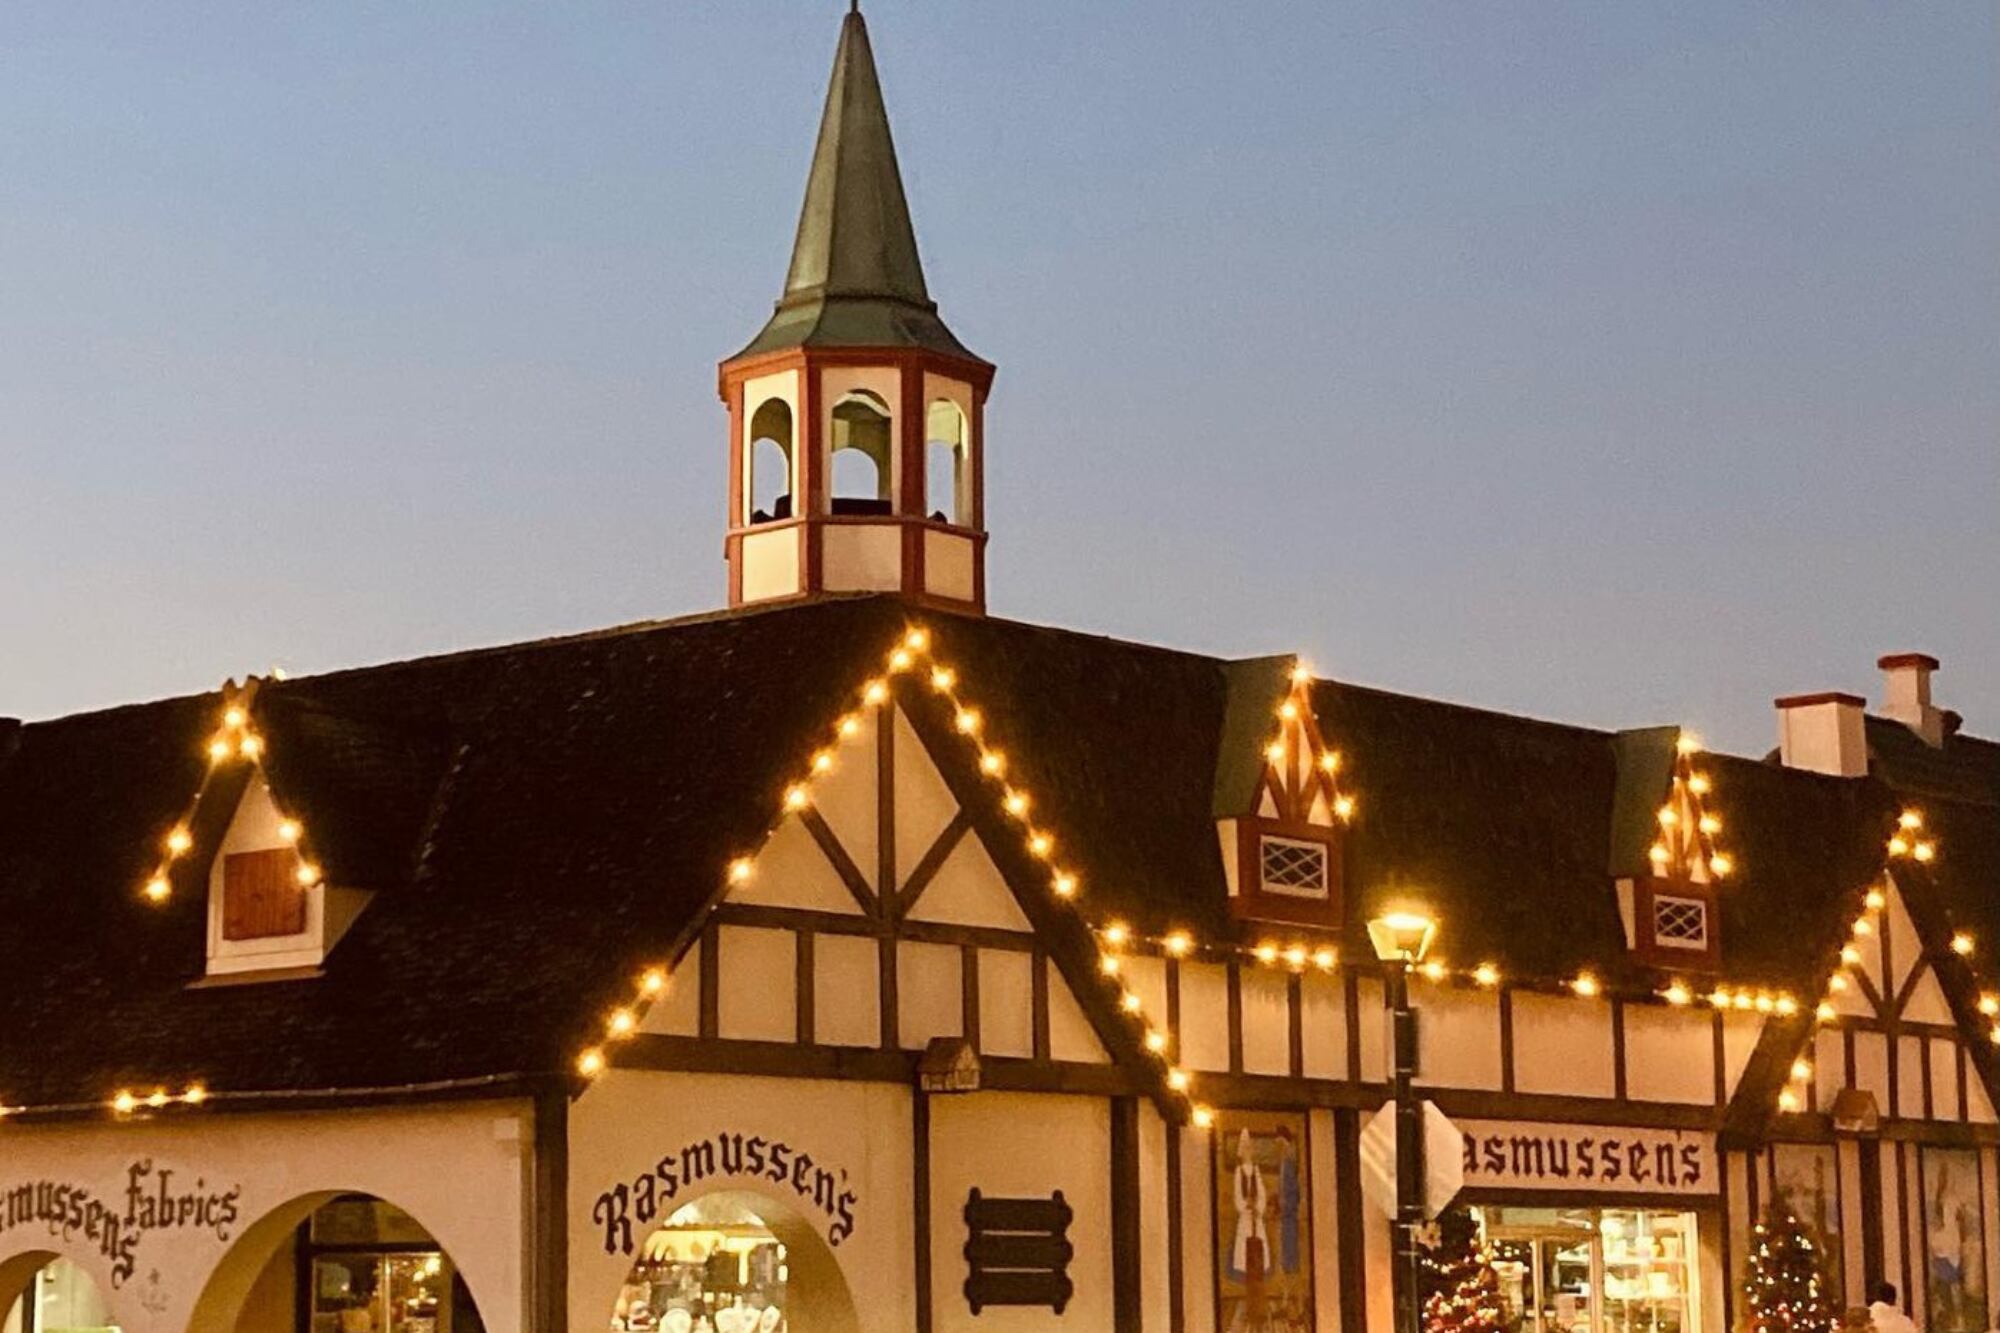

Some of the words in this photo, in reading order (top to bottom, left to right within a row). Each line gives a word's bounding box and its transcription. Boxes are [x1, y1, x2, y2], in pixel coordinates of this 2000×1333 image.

[592, 1131, 857, 1255] Rasmussen's
[1462, 1129, 1700, 1186] asmussen's
[0, 1181, 141, 1290] mussens
